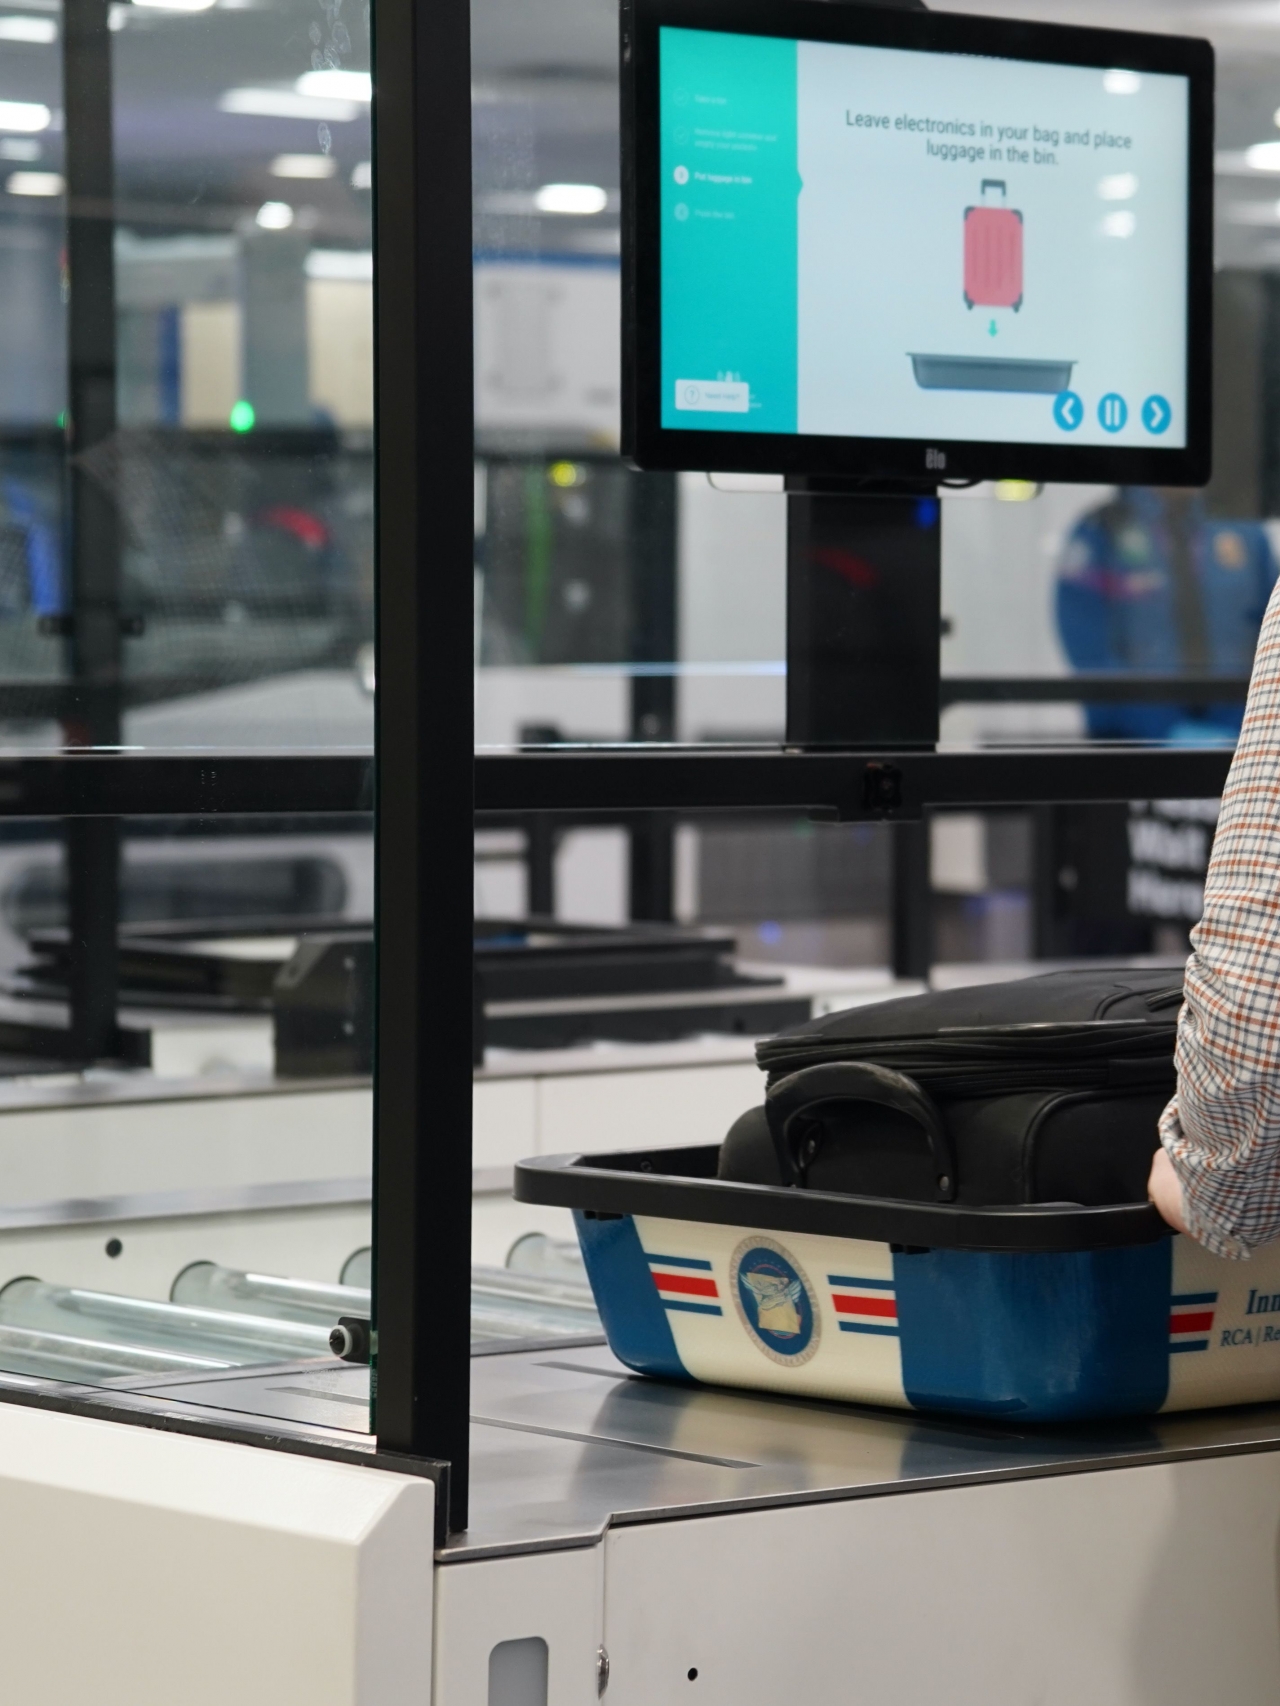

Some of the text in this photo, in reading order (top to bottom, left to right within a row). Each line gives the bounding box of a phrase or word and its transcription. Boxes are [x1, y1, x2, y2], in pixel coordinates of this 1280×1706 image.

[845, 109, 1132, 149] Leave electronics in your bag and place
[926, 138, 1059, 165] luggage in the bin.
[1220, 1328, 1254, 1347] RCA
